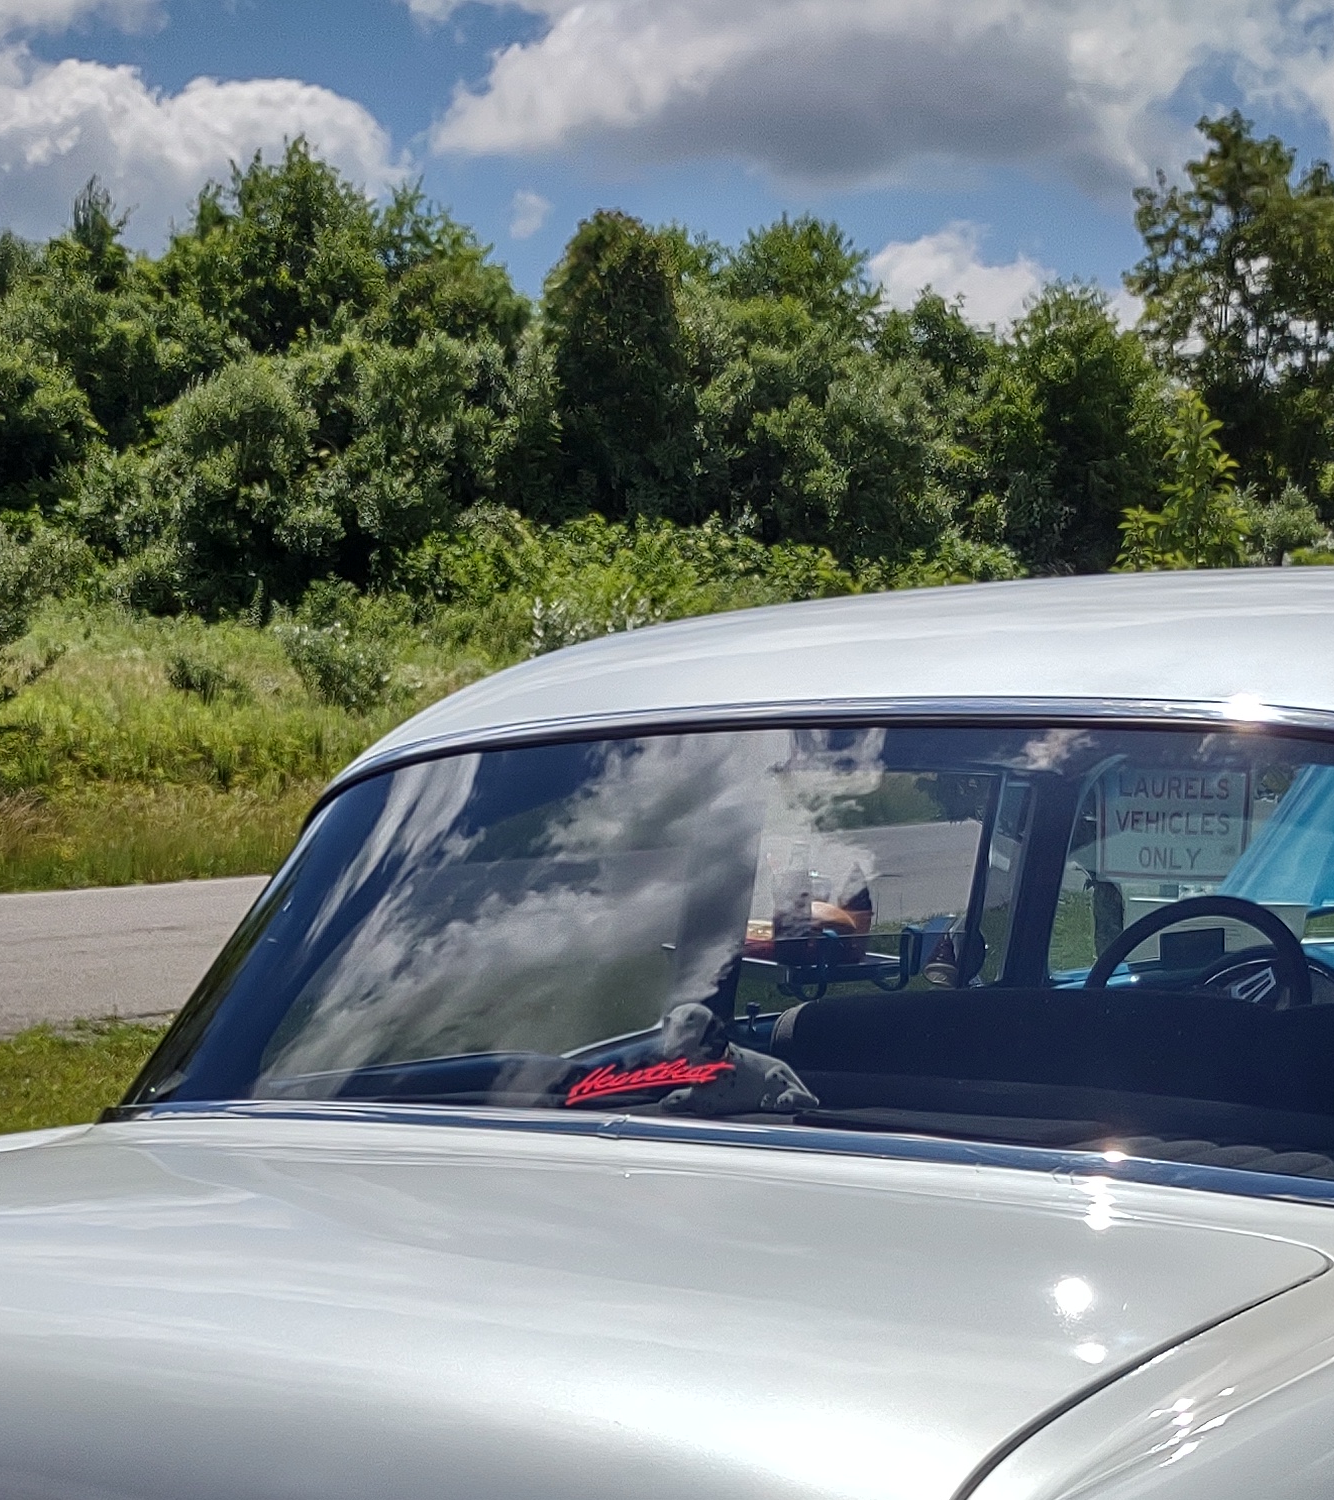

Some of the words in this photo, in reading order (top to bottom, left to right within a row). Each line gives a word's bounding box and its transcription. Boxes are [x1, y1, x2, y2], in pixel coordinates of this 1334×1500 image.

[1119, 777, 1230, 801] LAURELS
[1116, 811, 1230, 835] VEHICLES
[1138, 848, 1202, 870] ONLY
